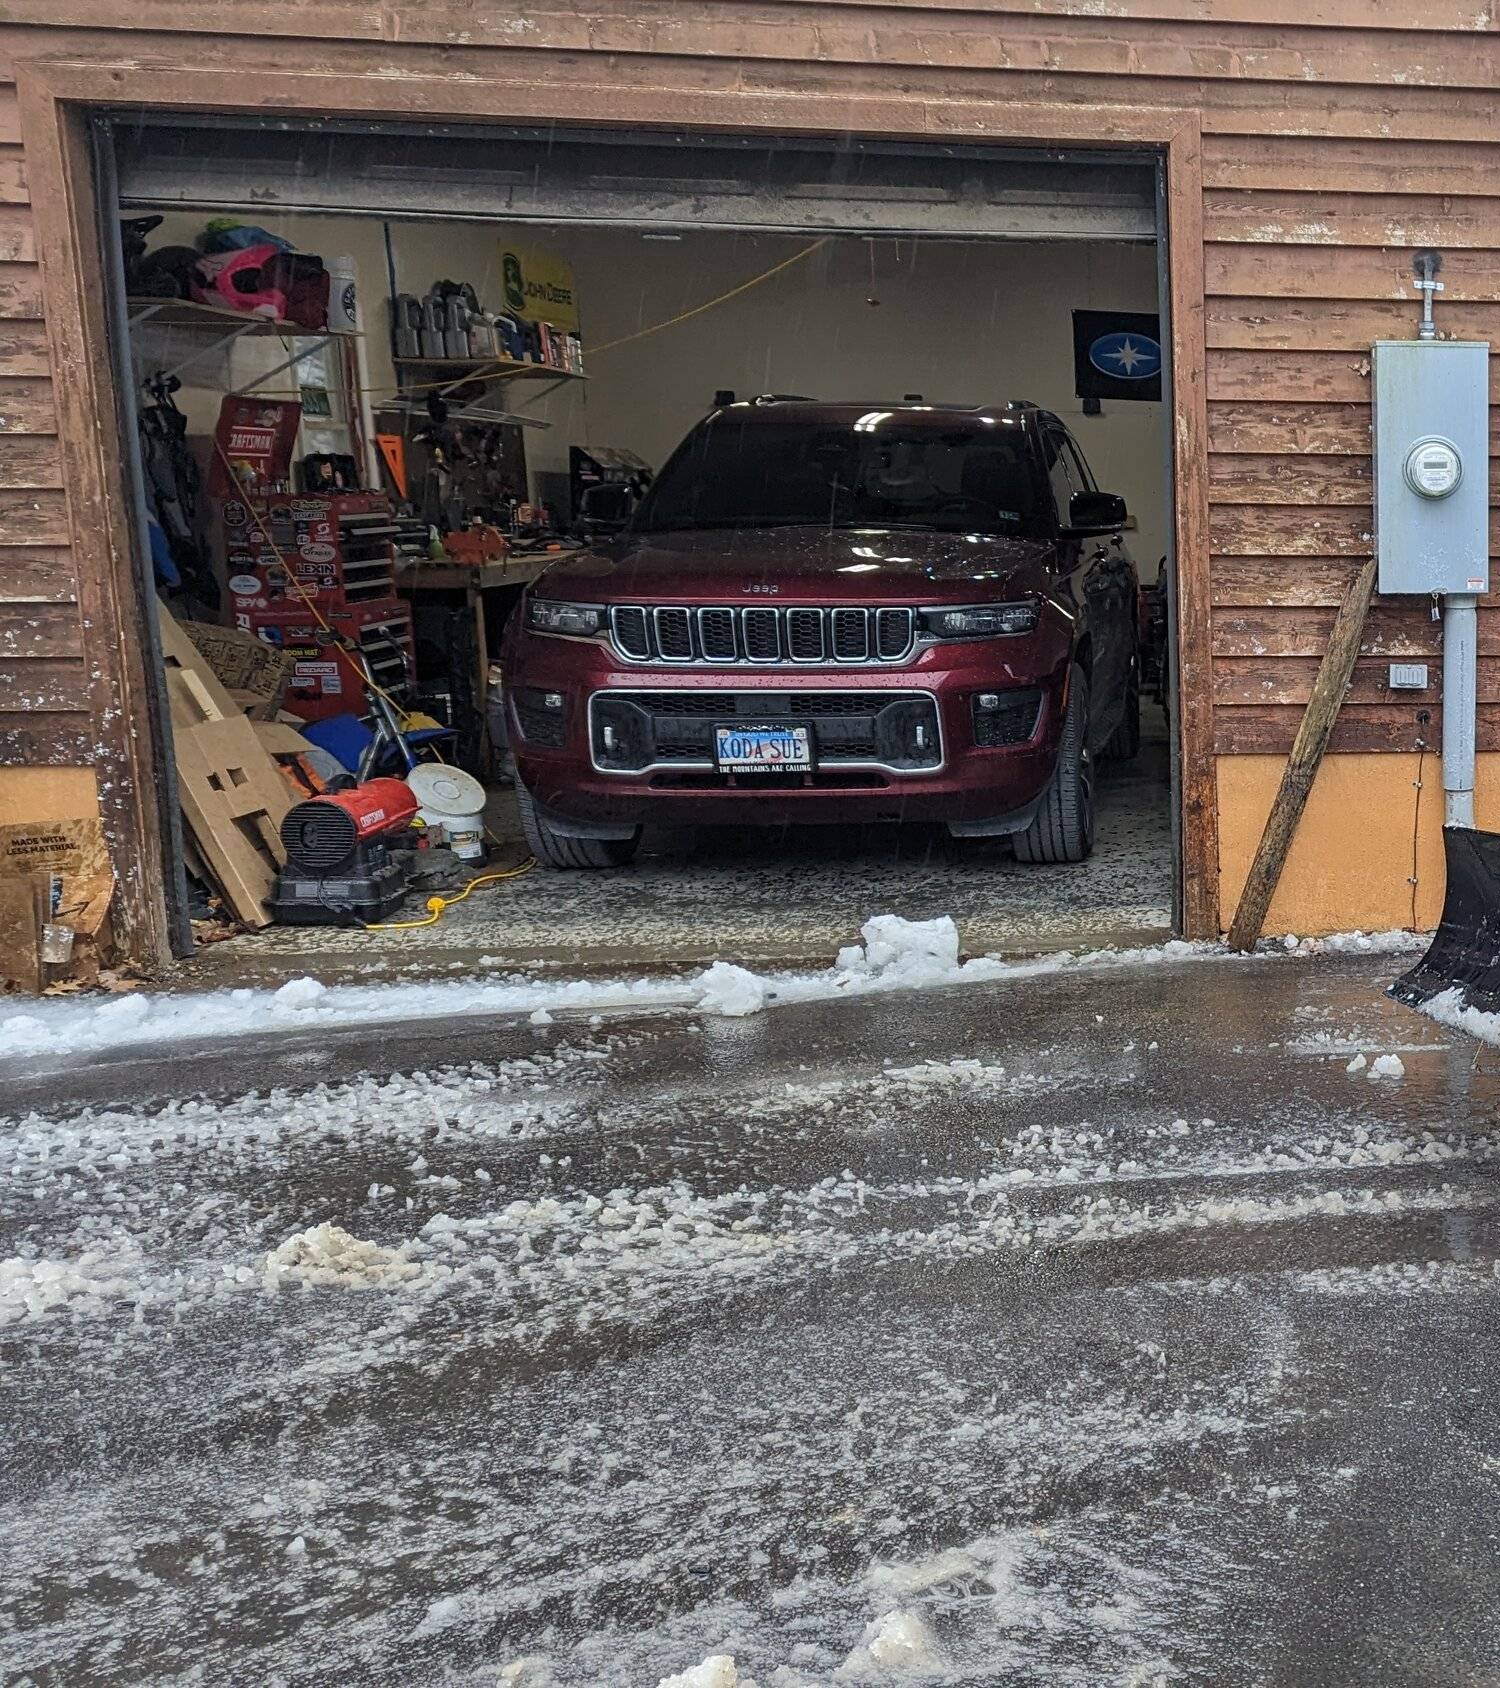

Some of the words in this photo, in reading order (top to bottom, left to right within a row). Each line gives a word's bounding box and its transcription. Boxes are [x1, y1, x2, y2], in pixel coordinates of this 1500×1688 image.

[297, 563, 335, 575] LEXIN
[742, 583, 779, 595] Jeep
[719, 738, 763, 759] KODA
[770, 738, 804, 759] SUE
[732, 765, 770, 773] MOUNTAINS
[772, 764, 784, 772] ARE
[786, 764, 811, 772] CALLING
[11, 837, 39, 846] MADE
[41, 835, 66, 844] WITH
[7, 847, 29, 856] LESS
[30, 842, 77, 854] MATERIAL
